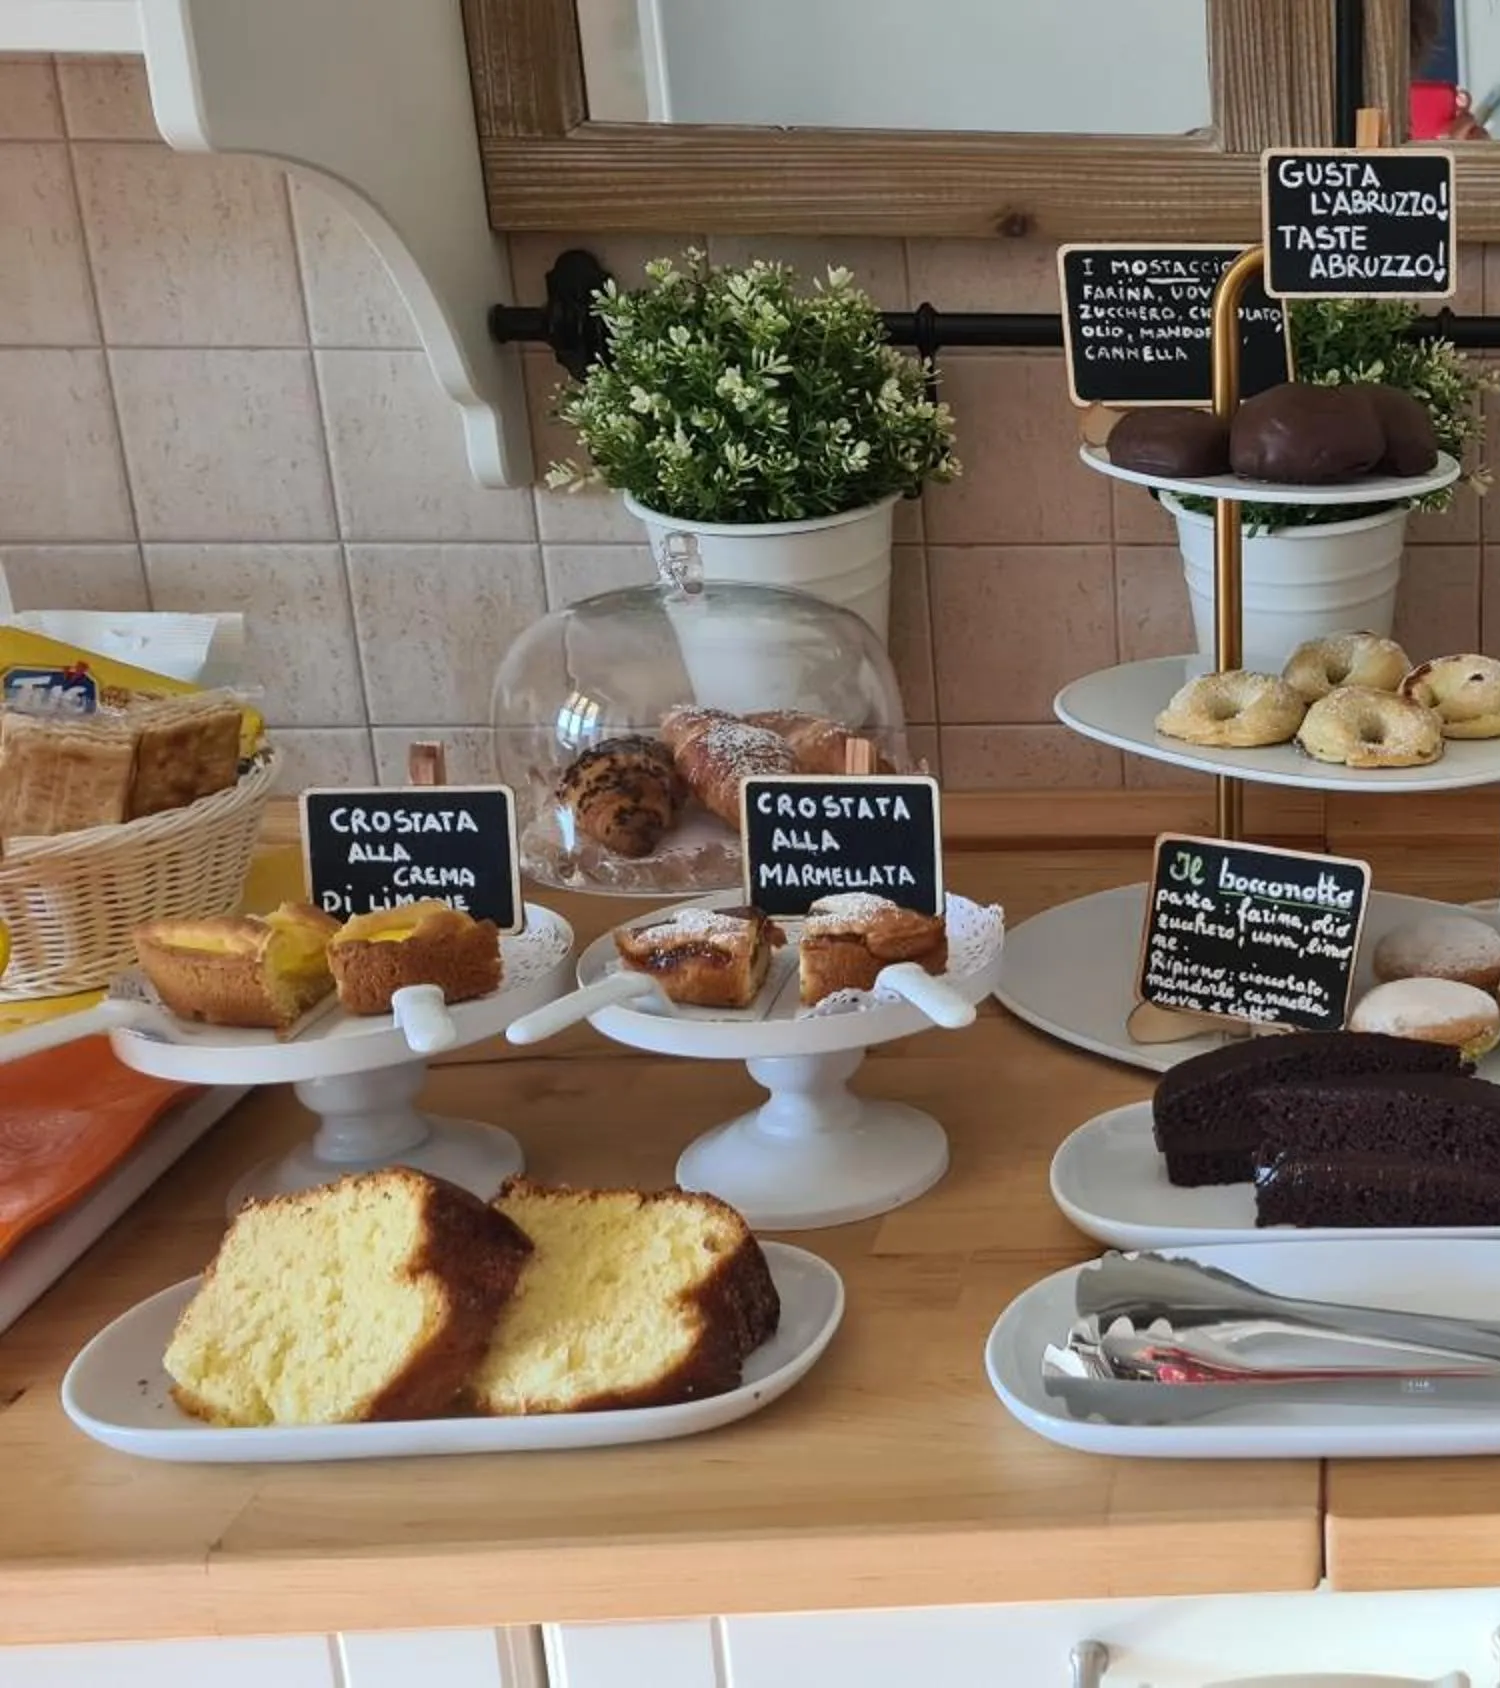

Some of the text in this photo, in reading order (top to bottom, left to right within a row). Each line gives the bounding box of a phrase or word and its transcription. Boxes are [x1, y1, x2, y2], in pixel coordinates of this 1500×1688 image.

[1278, 159, 1381, 188] GUSTA
[1310, 181, 1448, 221] L'ABRUZZO!
[1277, 224, 1368, 250] TASTE
[1081, 258, 1094, 276] I
[1309, 240, 1446, 283] ABRUZZO!
[1170, 286, 1212, 300] UOV
[1084, 346, 1189, 362] CANNELLA
[757, 792, 911, 822] CROSTATA
[329, 807, 478, 834] CROSTATA
[348, 841, 411, 864] ALLA
[772, 828, 840, 852] ALLA
[393, 865, 475, 887] CREMA
[759, 863, 915, 888] MARMELLATA
